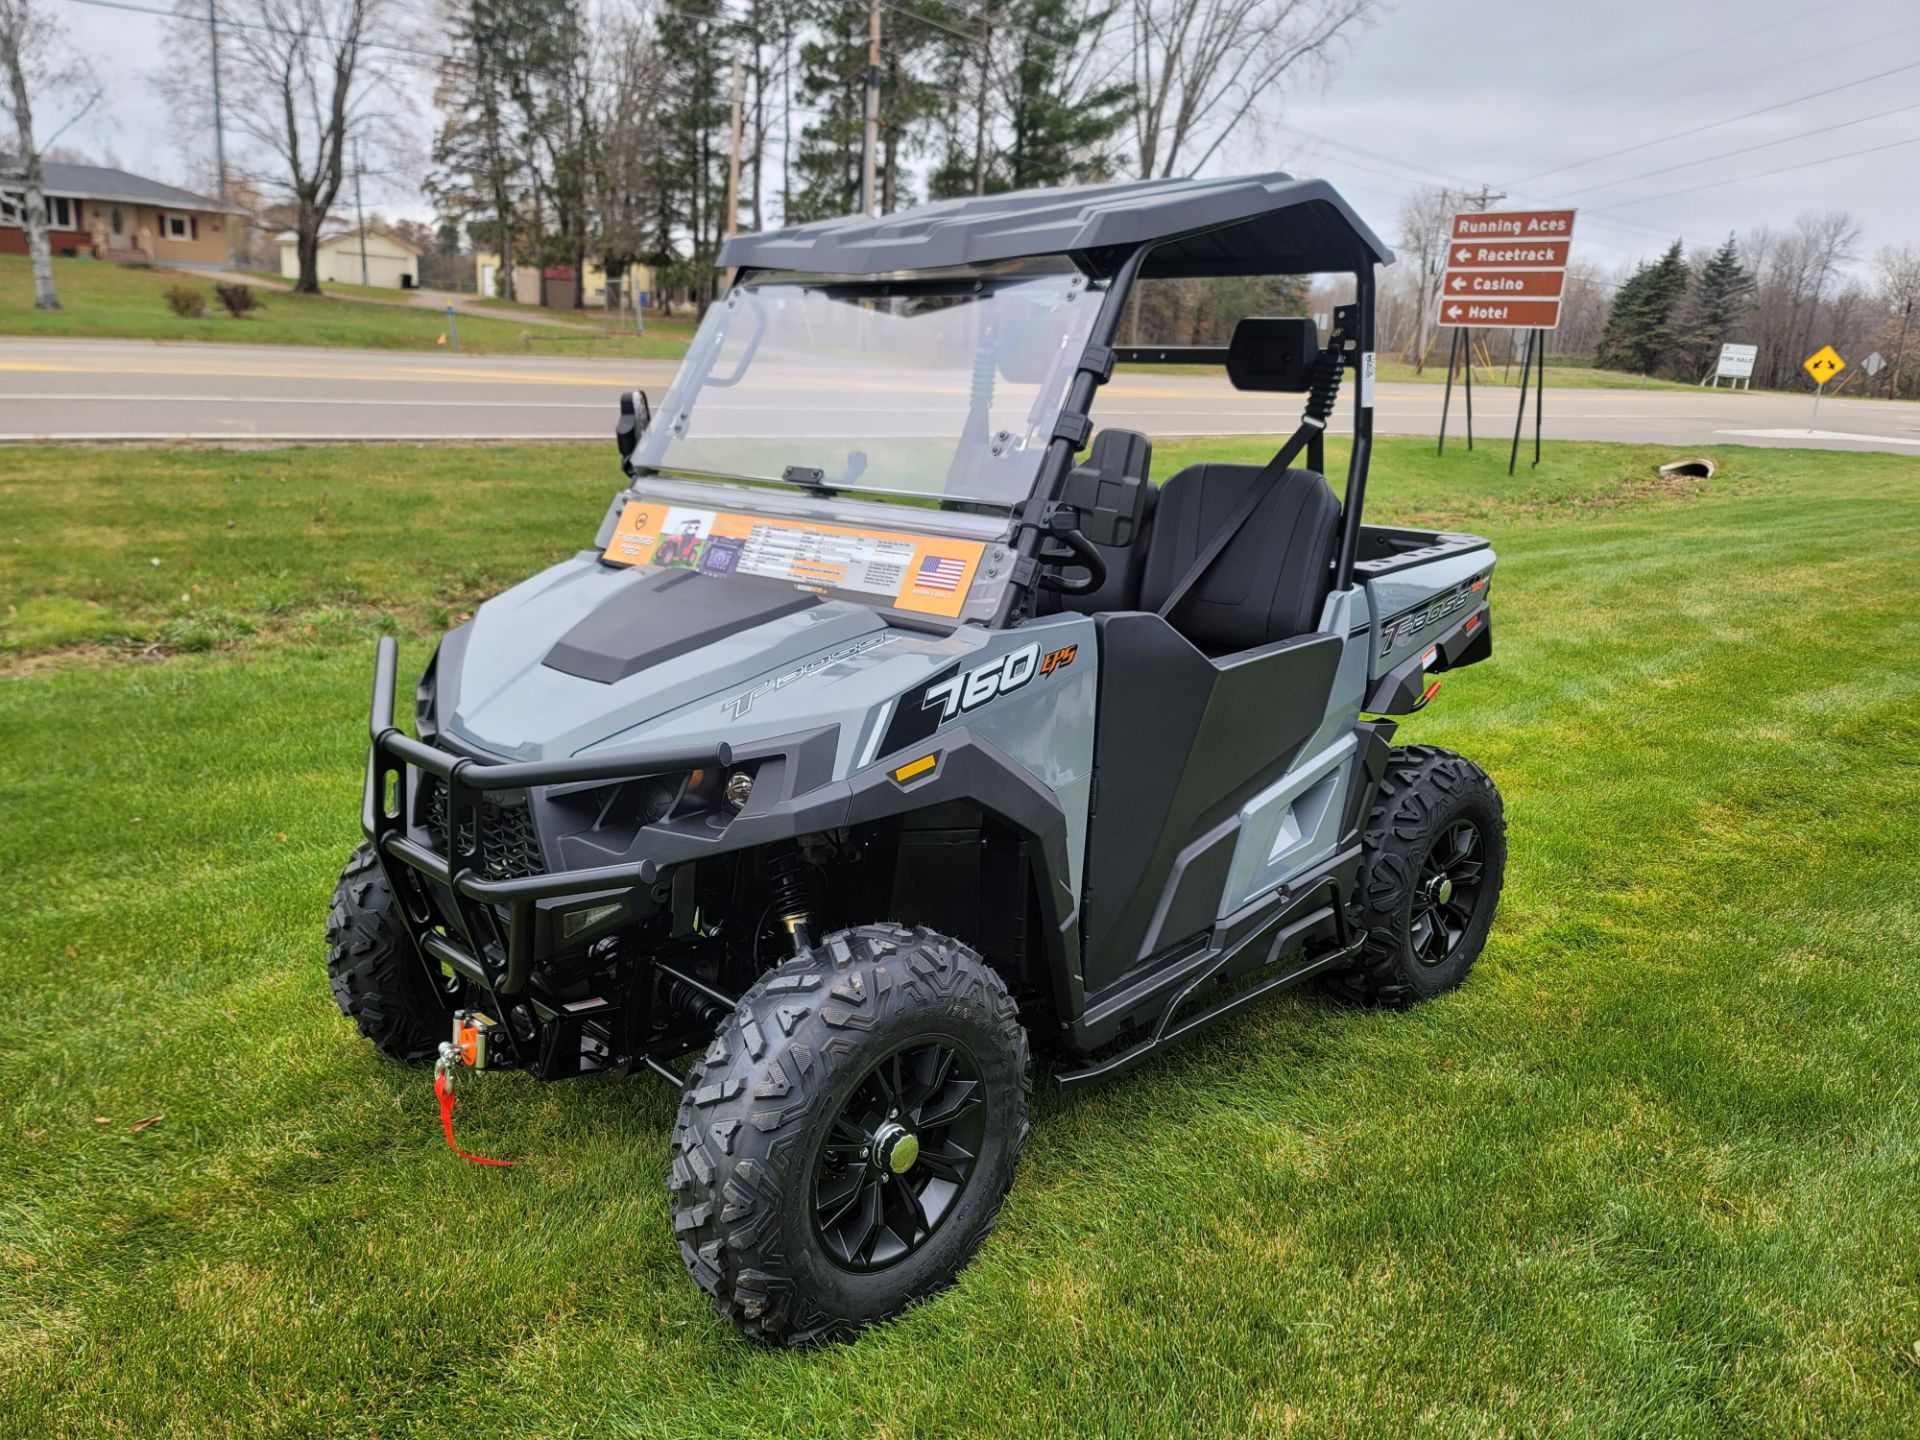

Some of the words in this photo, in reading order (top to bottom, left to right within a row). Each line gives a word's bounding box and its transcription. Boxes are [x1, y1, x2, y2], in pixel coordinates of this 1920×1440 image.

[1459, 219, 1522, 235] Running
[1527, 218, 1567, 232] Aces
[1477, 248, 1556, 262] Racetrack
[1473, 277, 1524, 291] Casino
[1468, 306, 1508, 319] Hotel
[1380, 588, 1471, 658] T-BOSS
[922, 641, 1042, 725] 760
[1039, 643, 1079, 680] EPS
